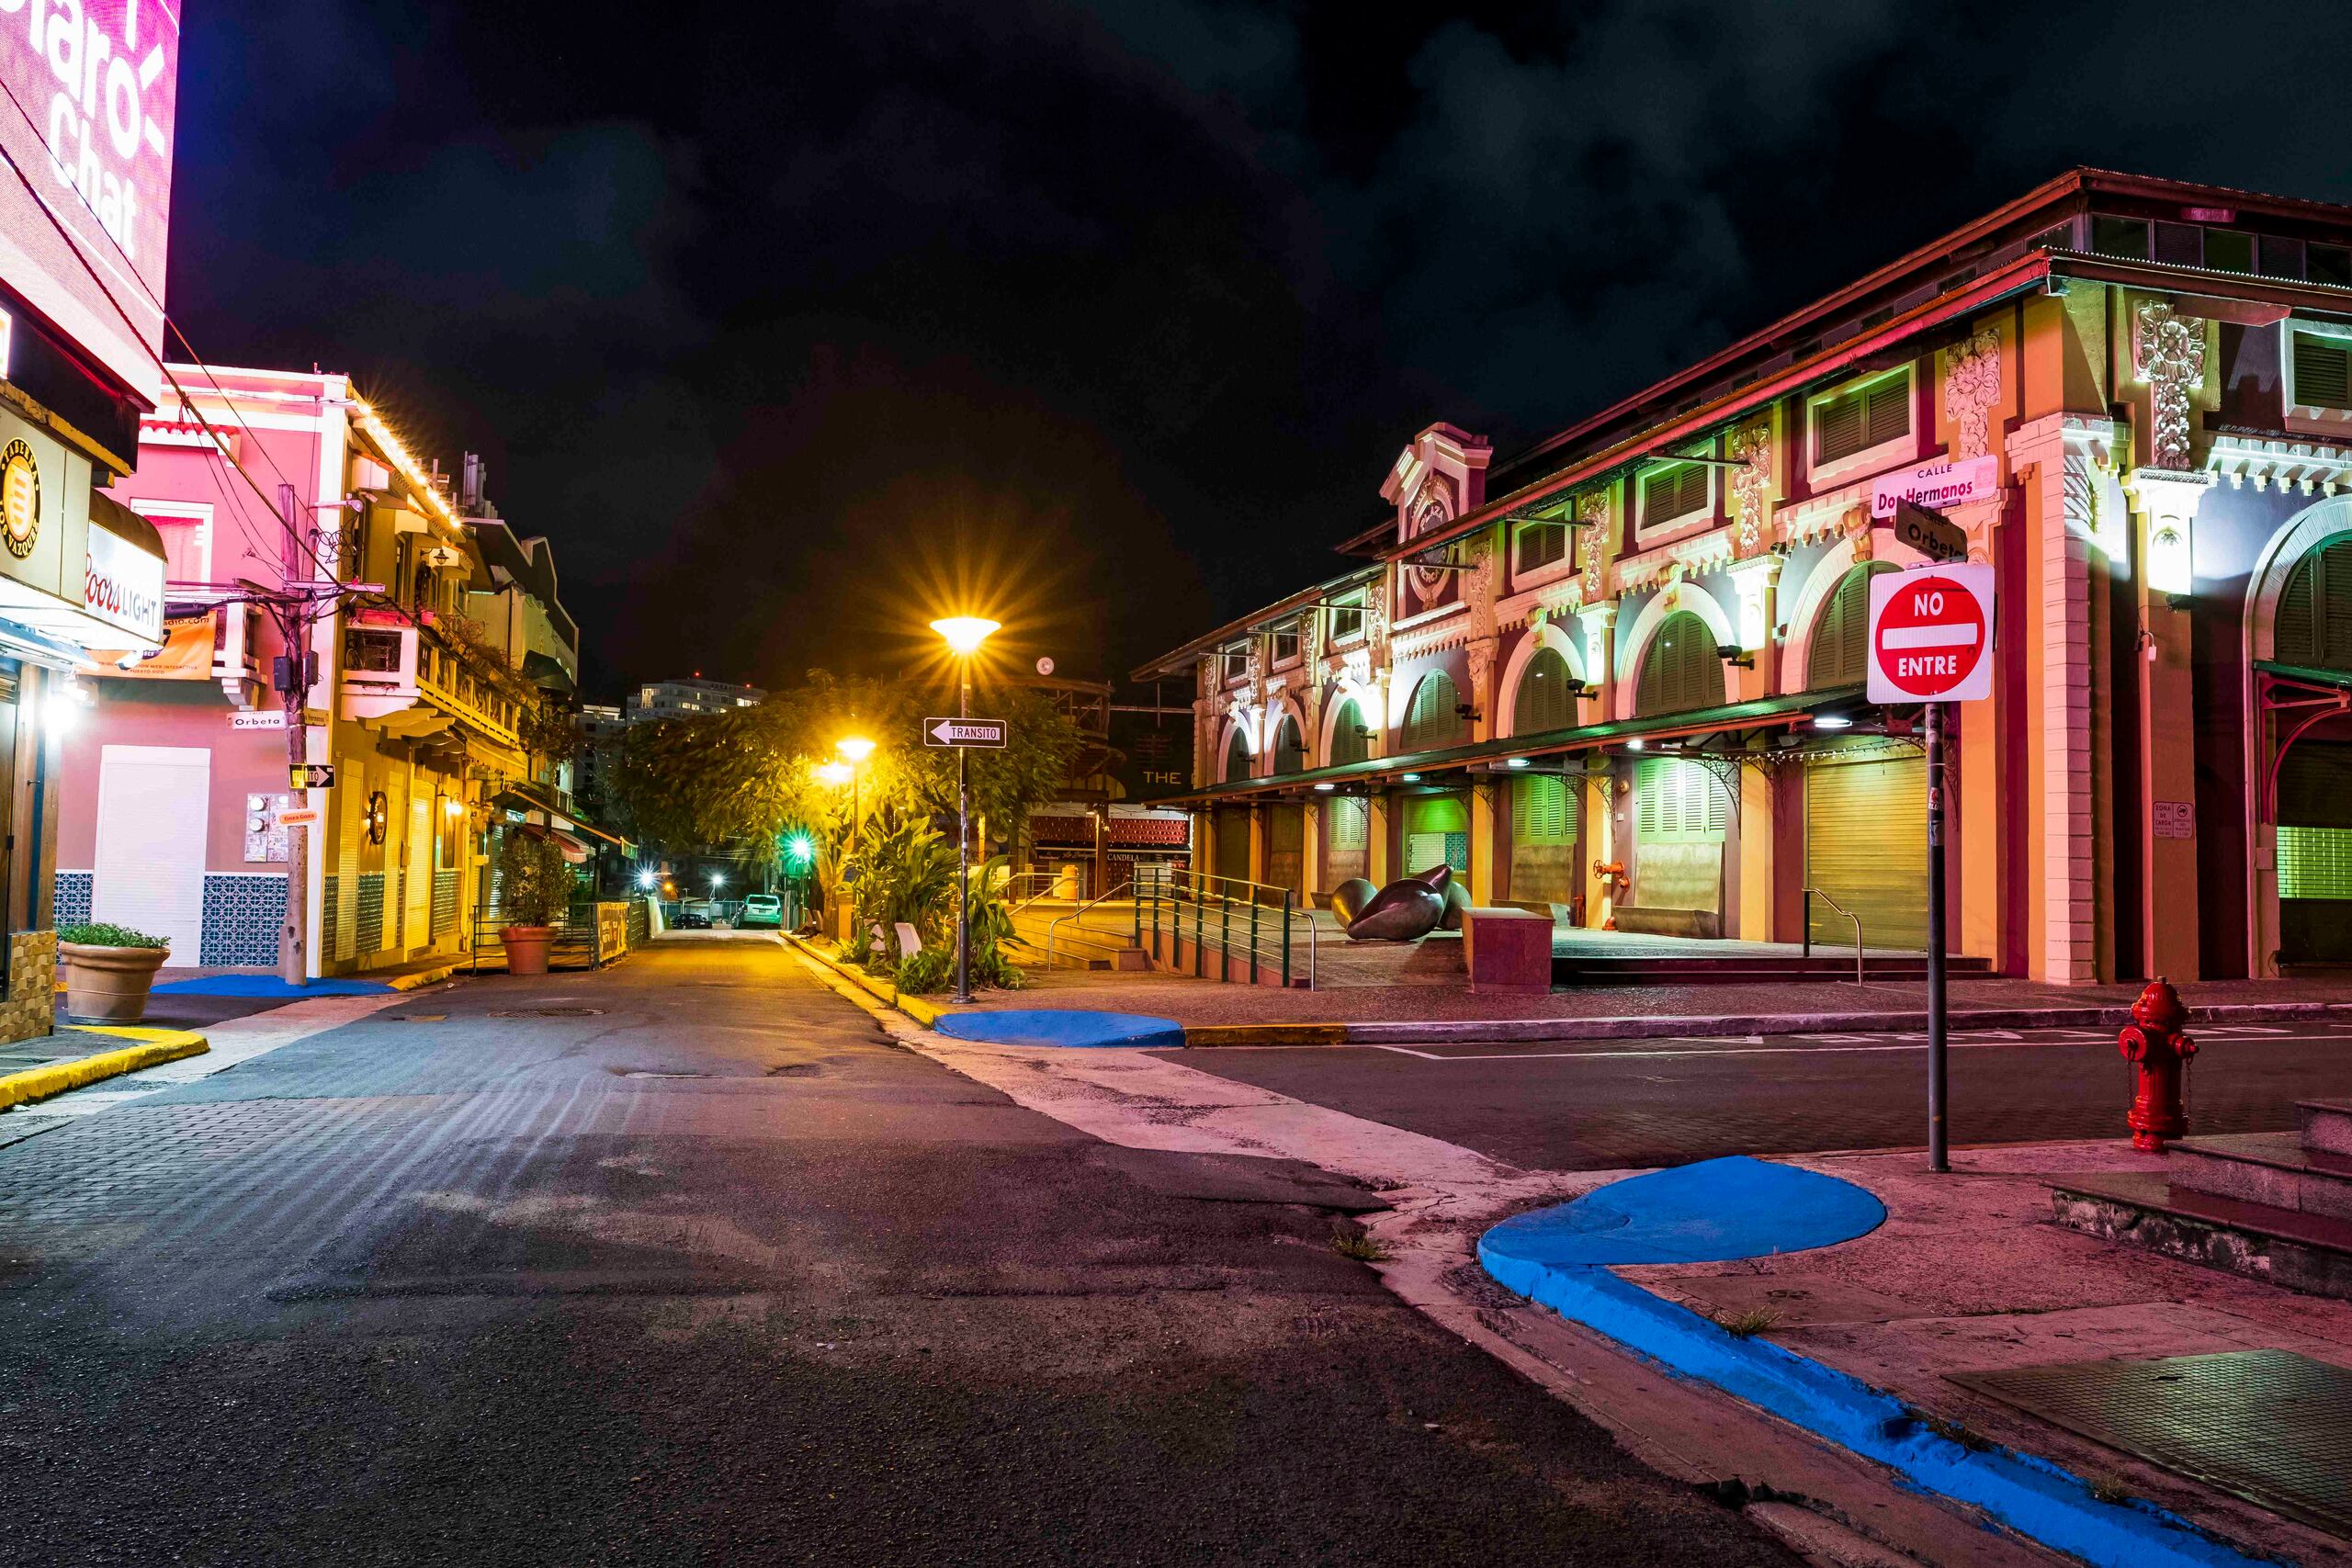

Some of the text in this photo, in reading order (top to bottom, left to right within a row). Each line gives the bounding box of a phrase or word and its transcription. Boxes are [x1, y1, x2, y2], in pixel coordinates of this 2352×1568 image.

[0, 0, 140, 160] laro
[50, 92, 136, 261] Chat
[4, 440, 38, 480] TABERNA
[1917, 464, 1952, 478] CALLE
[1878, 481, 1973, 511] Do Hermanos
[122, 587, 157, 626] LIGHT
[1914, 592, 1944, 616] NO
[1898, 655, 1957, 677] ENTRE
[951, 727, 997, 739] TRANSITO
[1143, 772, 1182, 784] THE
[1107, 853, 1140, 862] CANDELA
